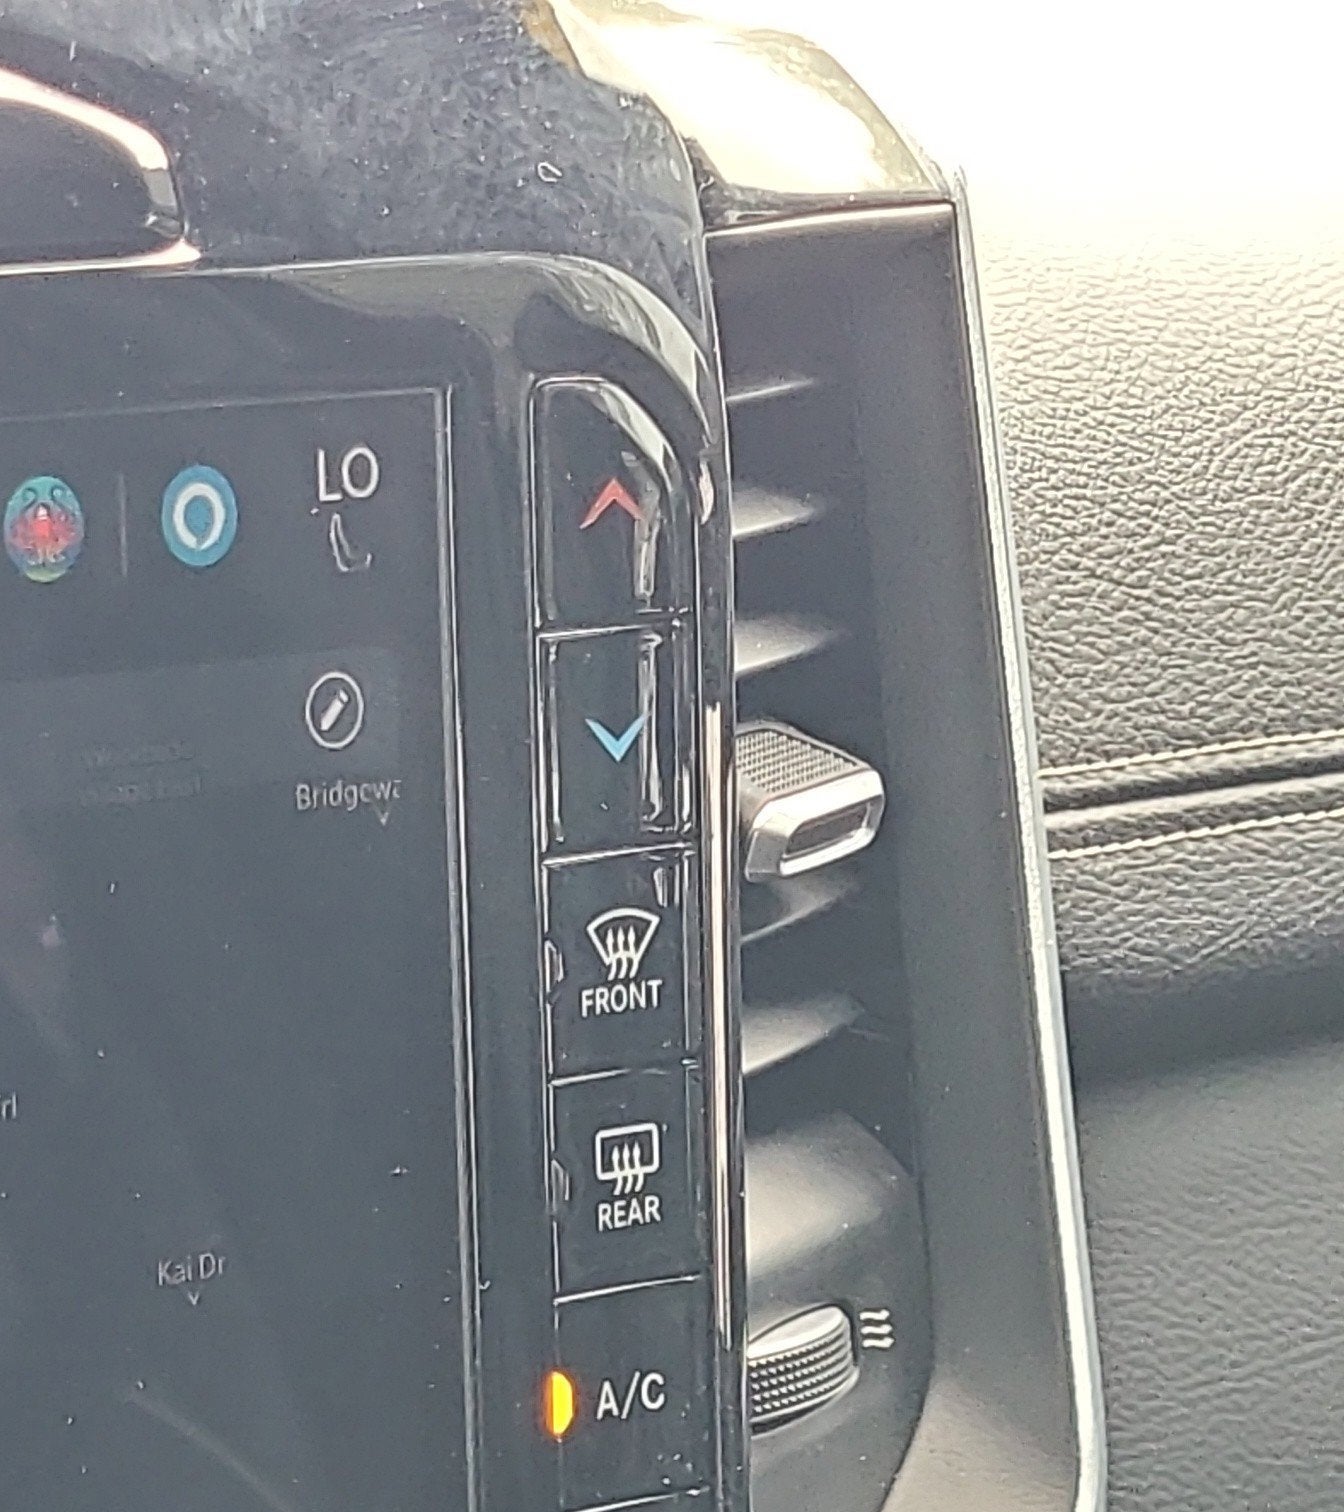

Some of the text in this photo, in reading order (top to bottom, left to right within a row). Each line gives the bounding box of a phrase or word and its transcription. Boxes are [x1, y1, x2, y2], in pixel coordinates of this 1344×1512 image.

[316, 444, 380, 505] LO
[580, 978, 664, 1018] FRONT
[597, 1195, 662, 1233] REAR
[156, 1251, 227, 1287] Kai Dr
[595, 1370, 666, 1421] A/C
